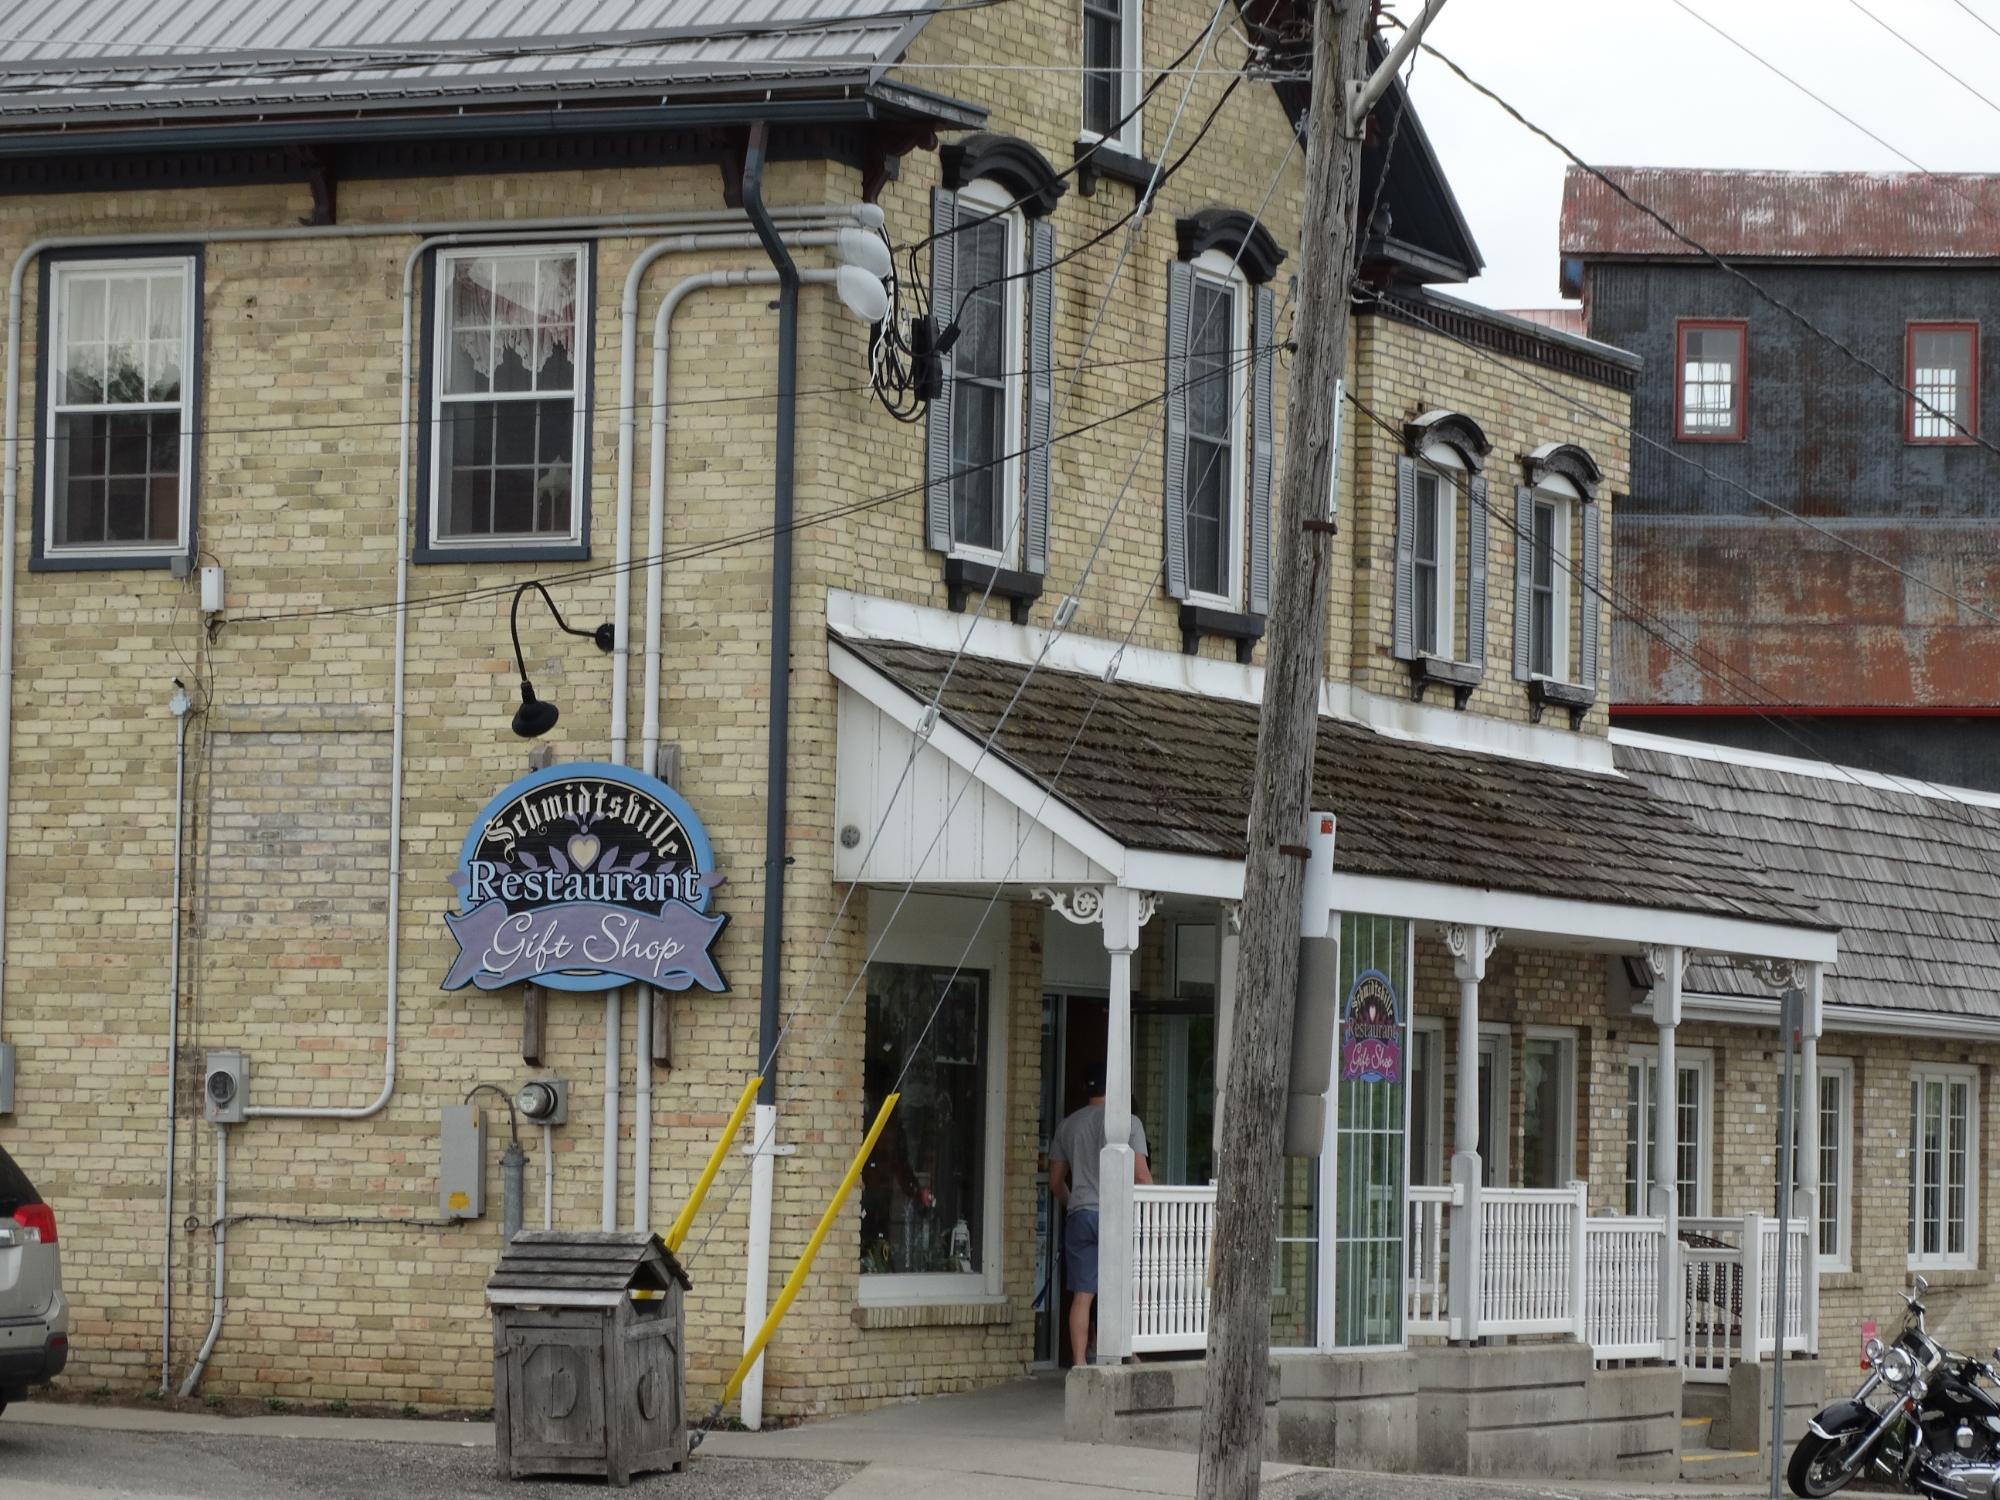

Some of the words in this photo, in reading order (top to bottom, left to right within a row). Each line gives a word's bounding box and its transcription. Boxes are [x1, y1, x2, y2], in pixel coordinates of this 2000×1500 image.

[485, 783, 680, 863] Schmidtsville
[468, 860, 701, 901] Restaurant
[482, 912, 575, 973] Gift
[583, 913, 685, 977] Shop
[1350, 1043, 1370, 1073] Gift
[1371, 1044, 1393, 1076] Shop
